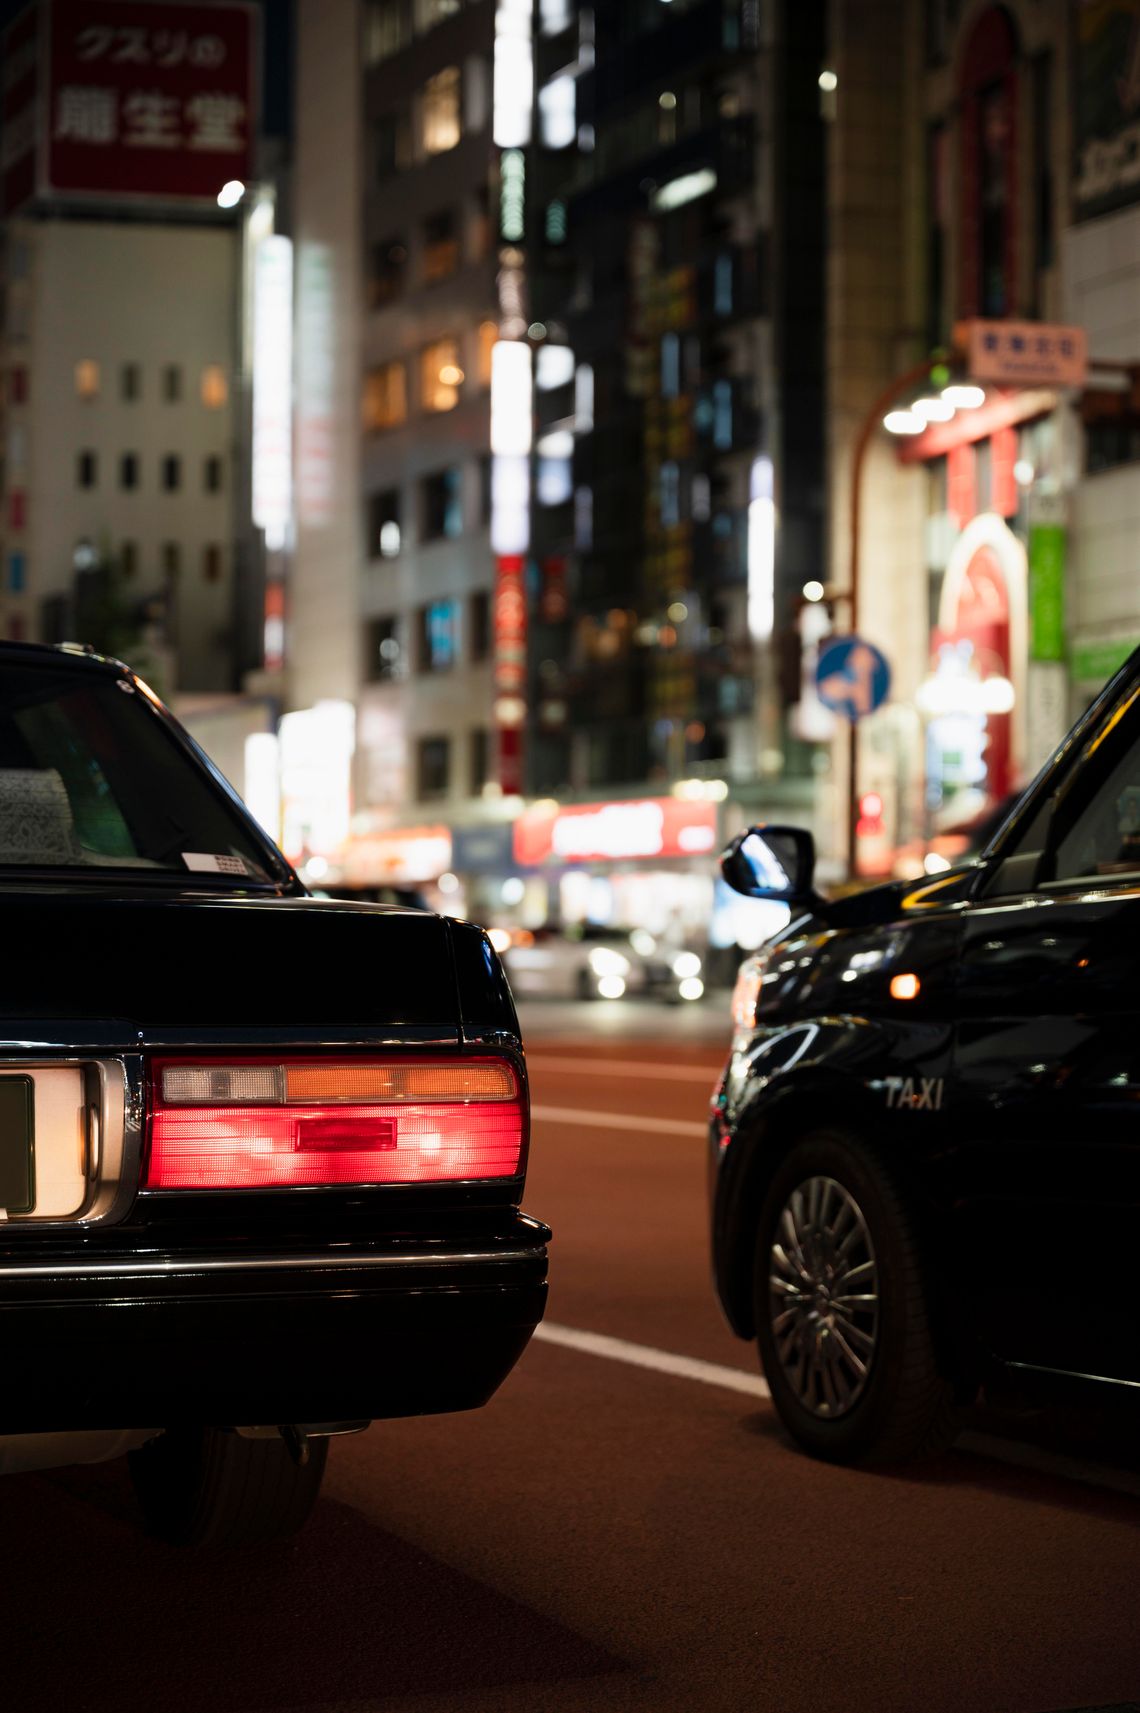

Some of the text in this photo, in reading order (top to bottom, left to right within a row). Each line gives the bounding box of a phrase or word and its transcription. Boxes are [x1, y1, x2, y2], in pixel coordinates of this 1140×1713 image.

[74, 24, 228, 69] クスリの
[884, 1076, 945, 1110] TAXI
